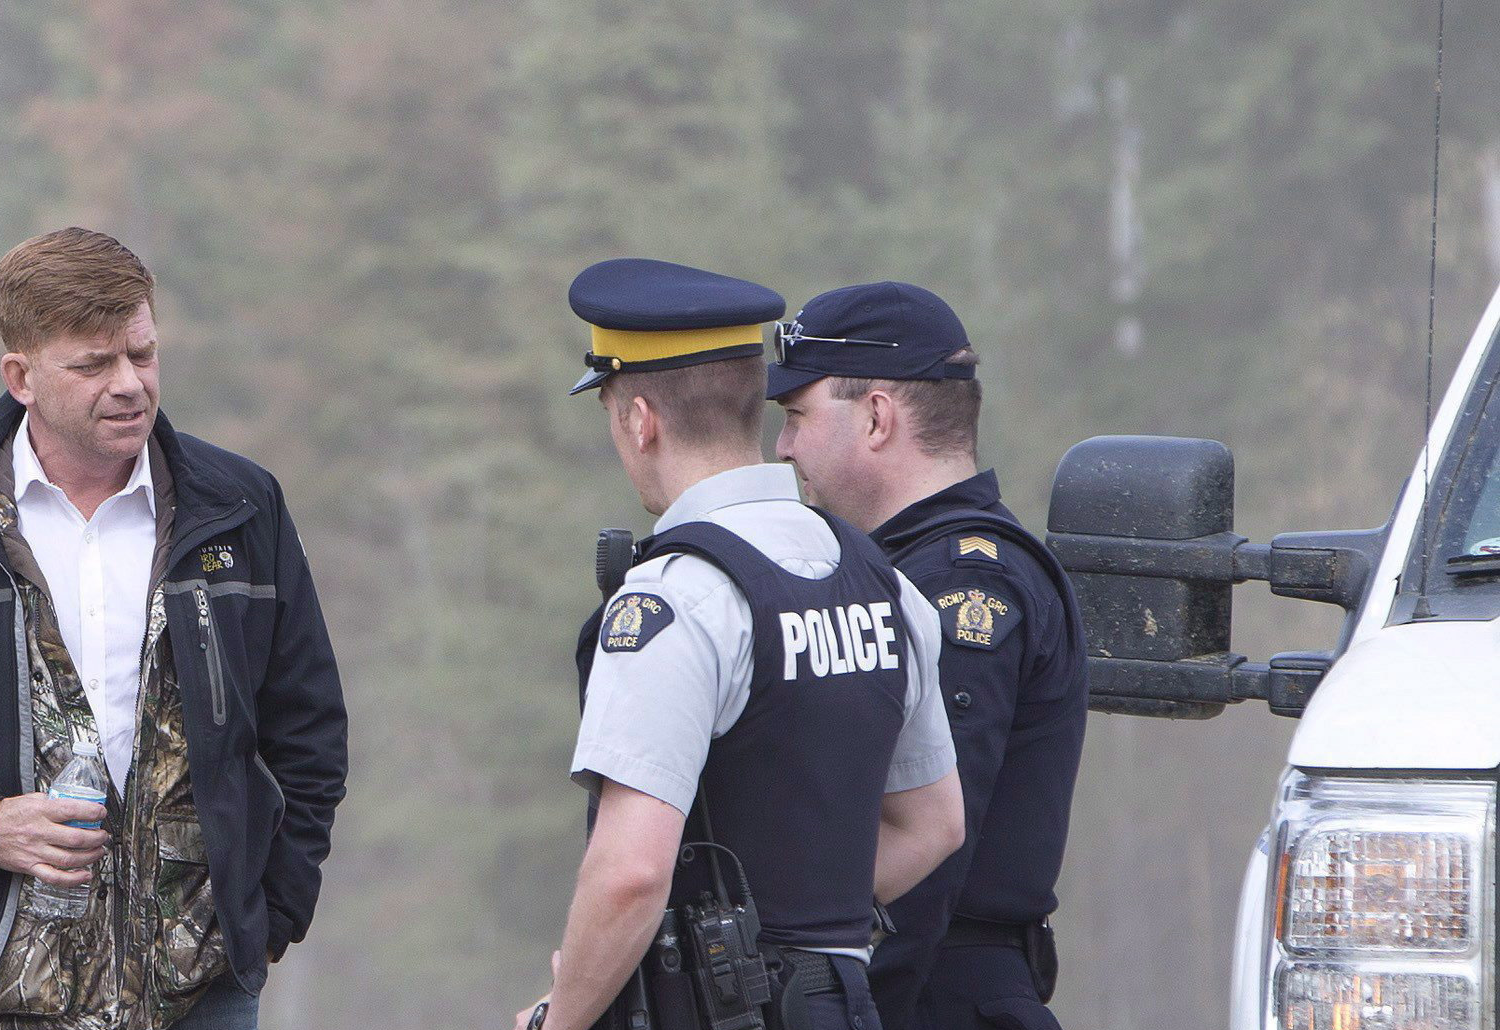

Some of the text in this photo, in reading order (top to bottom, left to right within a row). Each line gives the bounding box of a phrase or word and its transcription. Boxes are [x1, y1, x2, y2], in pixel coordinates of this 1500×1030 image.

[642, 598, 661, 614] GRC
[938, 592, 1008, 615] RCMP GRC
[608, 636, 638, 647] POLICE
[779, 602, 898, 680] POLICE
[957, 629, 991, 645] POLICE
